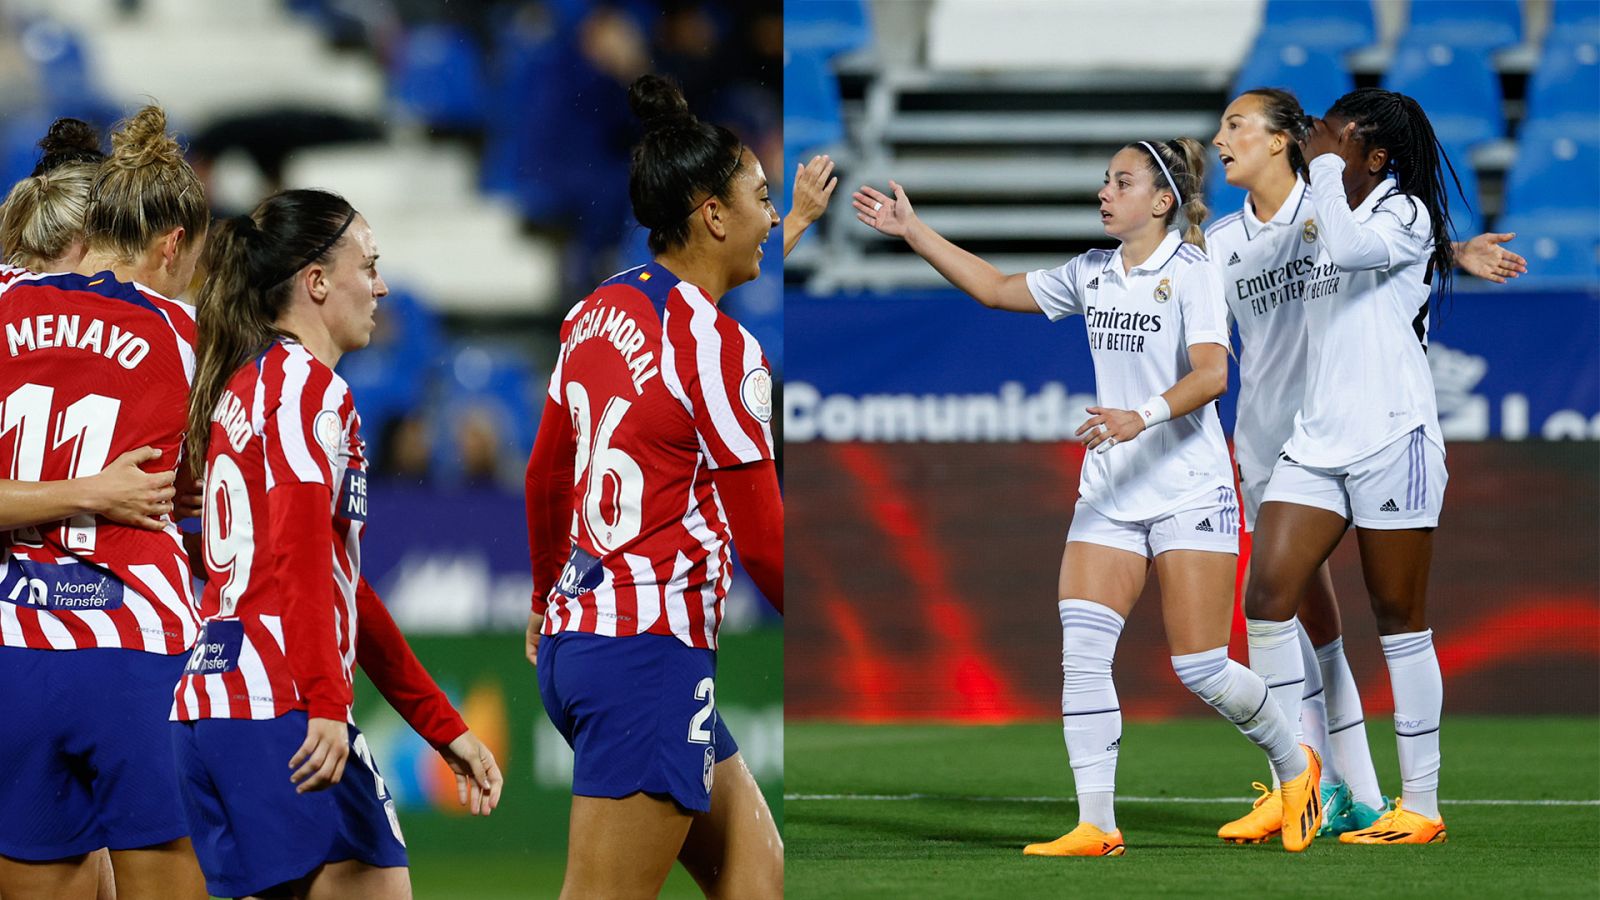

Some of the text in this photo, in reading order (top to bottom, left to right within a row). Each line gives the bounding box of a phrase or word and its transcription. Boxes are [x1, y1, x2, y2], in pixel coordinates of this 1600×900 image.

[1251, 295, 1268, 317] FLY
[1086, 306, 1161, 333] Emirates
[5, 314, 151, 370] MENAYO
[602, 306, 659, 396] MORAL
[1106, 332, 1145, 353] BETTER
[0, 382, 122, 556] 11
[55, 581, 103, 595] Money
[53, 594, 109, 607] Transfer
[205, 642, 225, 657] ney
